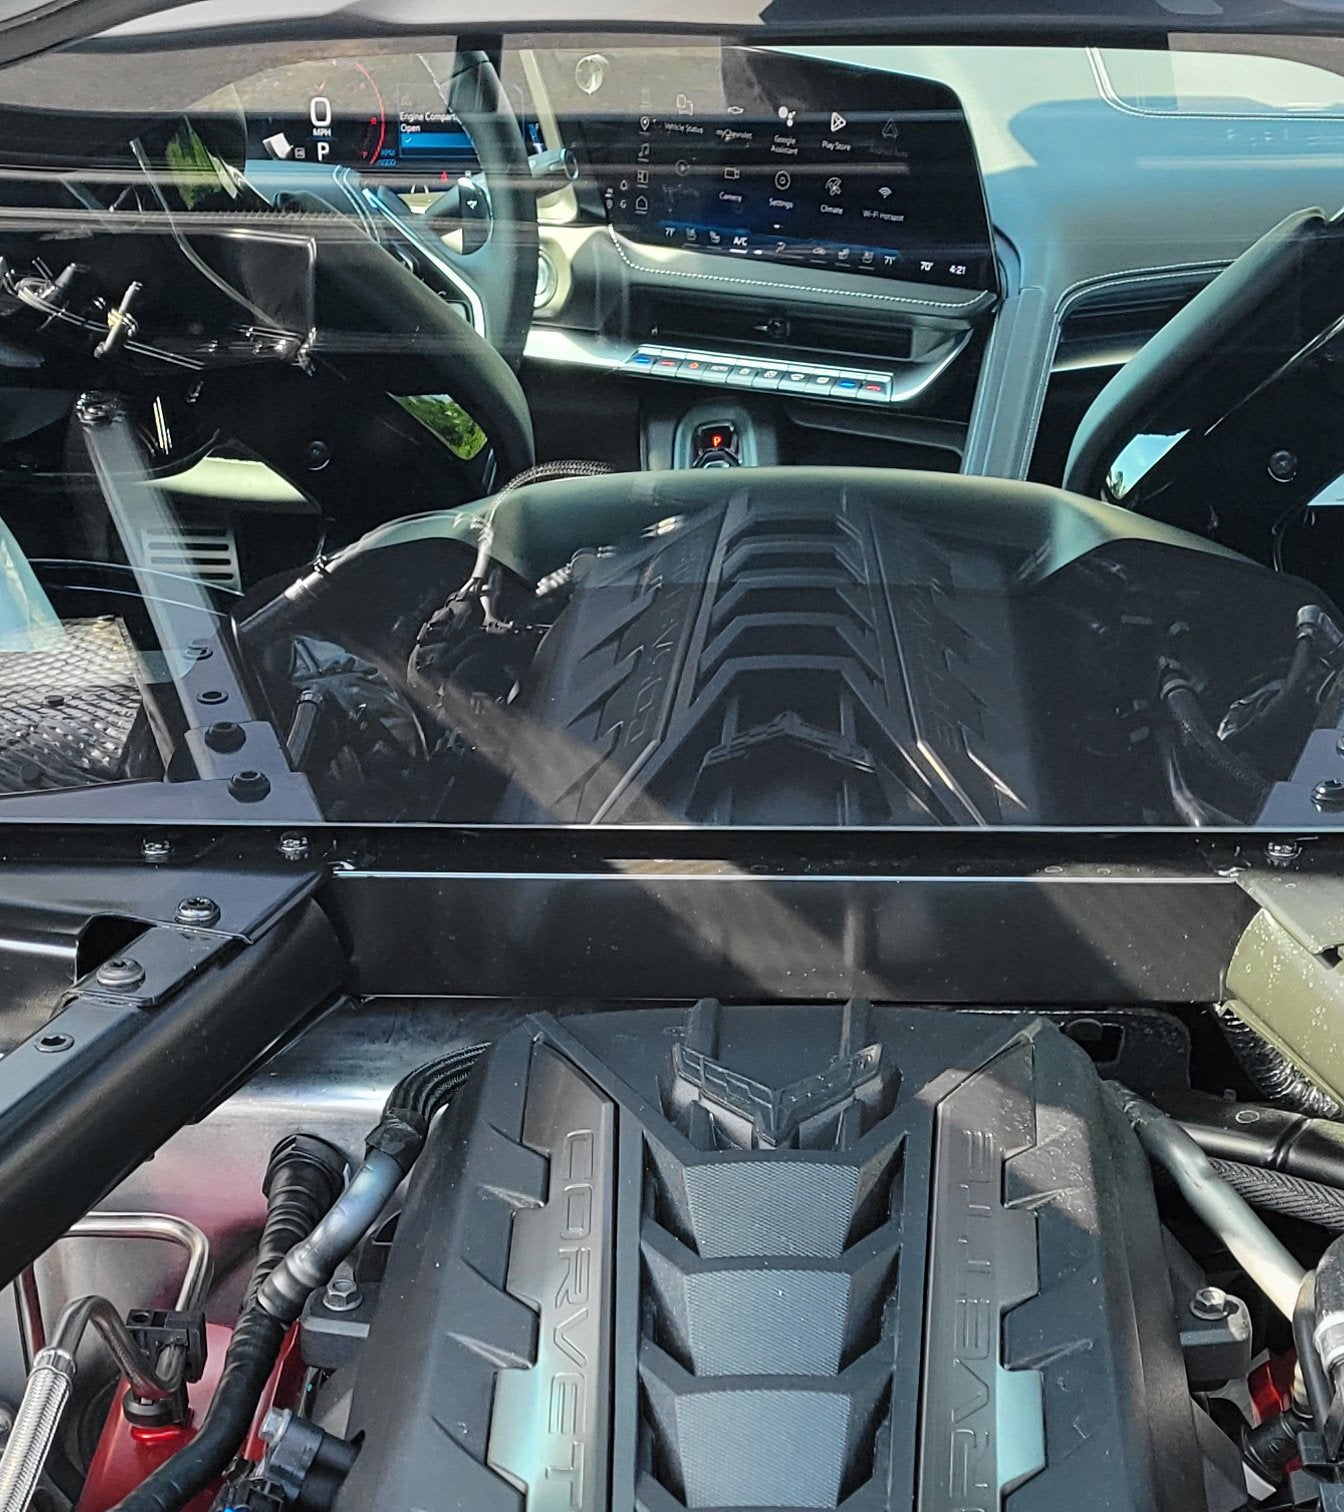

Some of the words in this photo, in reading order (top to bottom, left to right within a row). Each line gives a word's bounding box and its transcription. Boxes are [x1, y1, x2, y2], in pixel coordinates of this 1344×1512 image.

[310, 96, 331, 127] 0
[400, 112, 423, 123] Engine
[425, 112, 457, 123] Compart
[312, 128, 331, 137] MPH
[400, 124, 421, 133] Open
[664, 122, 685, 133] Vehicle
[686, 125, 703, 135] Status
[774, 135, 796, 146] Google
[822, 140, 835, 151] Play
[836, 142, 851, 151] Store
[318, 142, 329, 161] P
[770, 145, 798, 155] Assistant
[719, 191, 743, 203] Camera
[769, 198, 794, 209] Settings
[820, 204, 843, 215] Climate
[733, 236, 748, 247] A/C
[949, 265, 967, 275] 4:21
[712, 434, 722, 446] P
